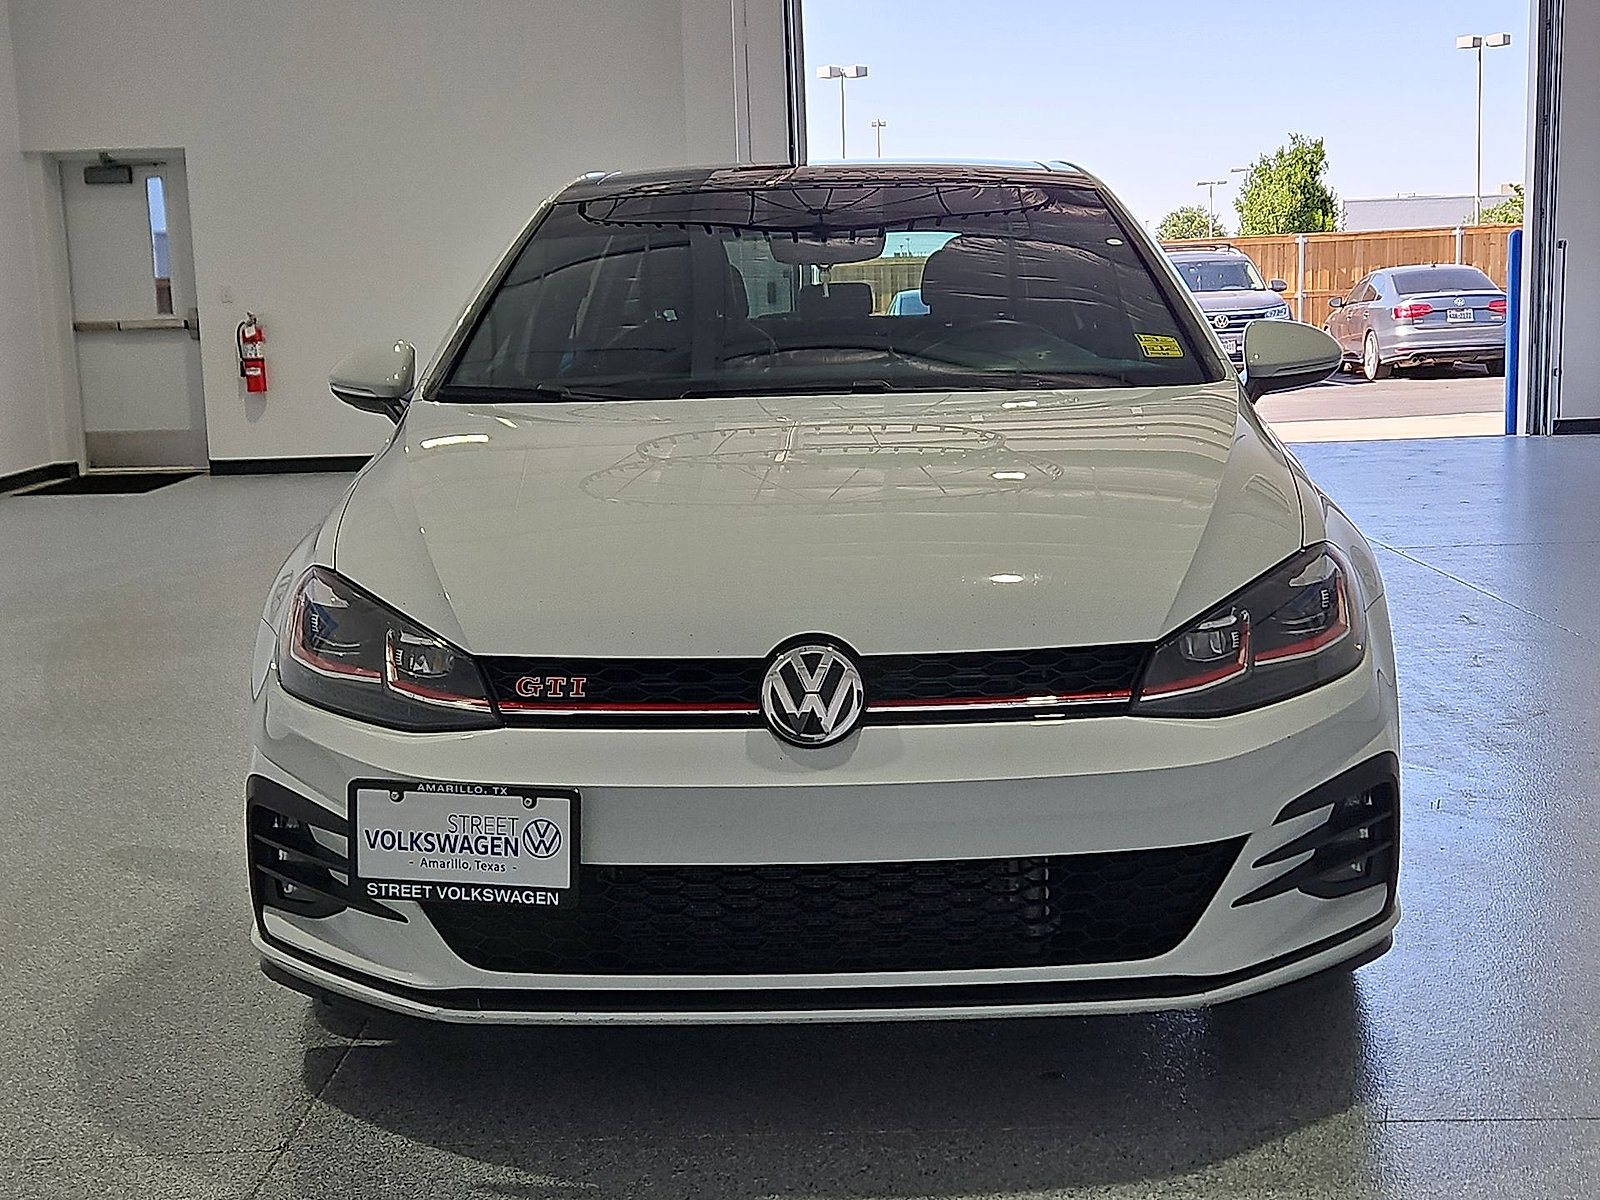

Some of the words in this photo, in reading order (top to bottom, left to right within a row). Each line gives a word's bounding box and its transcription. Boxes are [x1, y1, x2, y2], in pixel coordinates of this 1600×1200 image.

[515, 676, 587, 699] GTI
[417, 783, 487, 795] AMARILLO,
[492, 786, 508, 796] TX
[447, 814, 519, 837] STREET
[364, 829, 519, 857] VOLKSWAGEN
[420, 857, 472, 871] Amarillo,
[475, 860, 506, 873] Texas
[366, 882, 432, 899] STREET
[437, 885, 560, 906] VOLKSWAGEN
